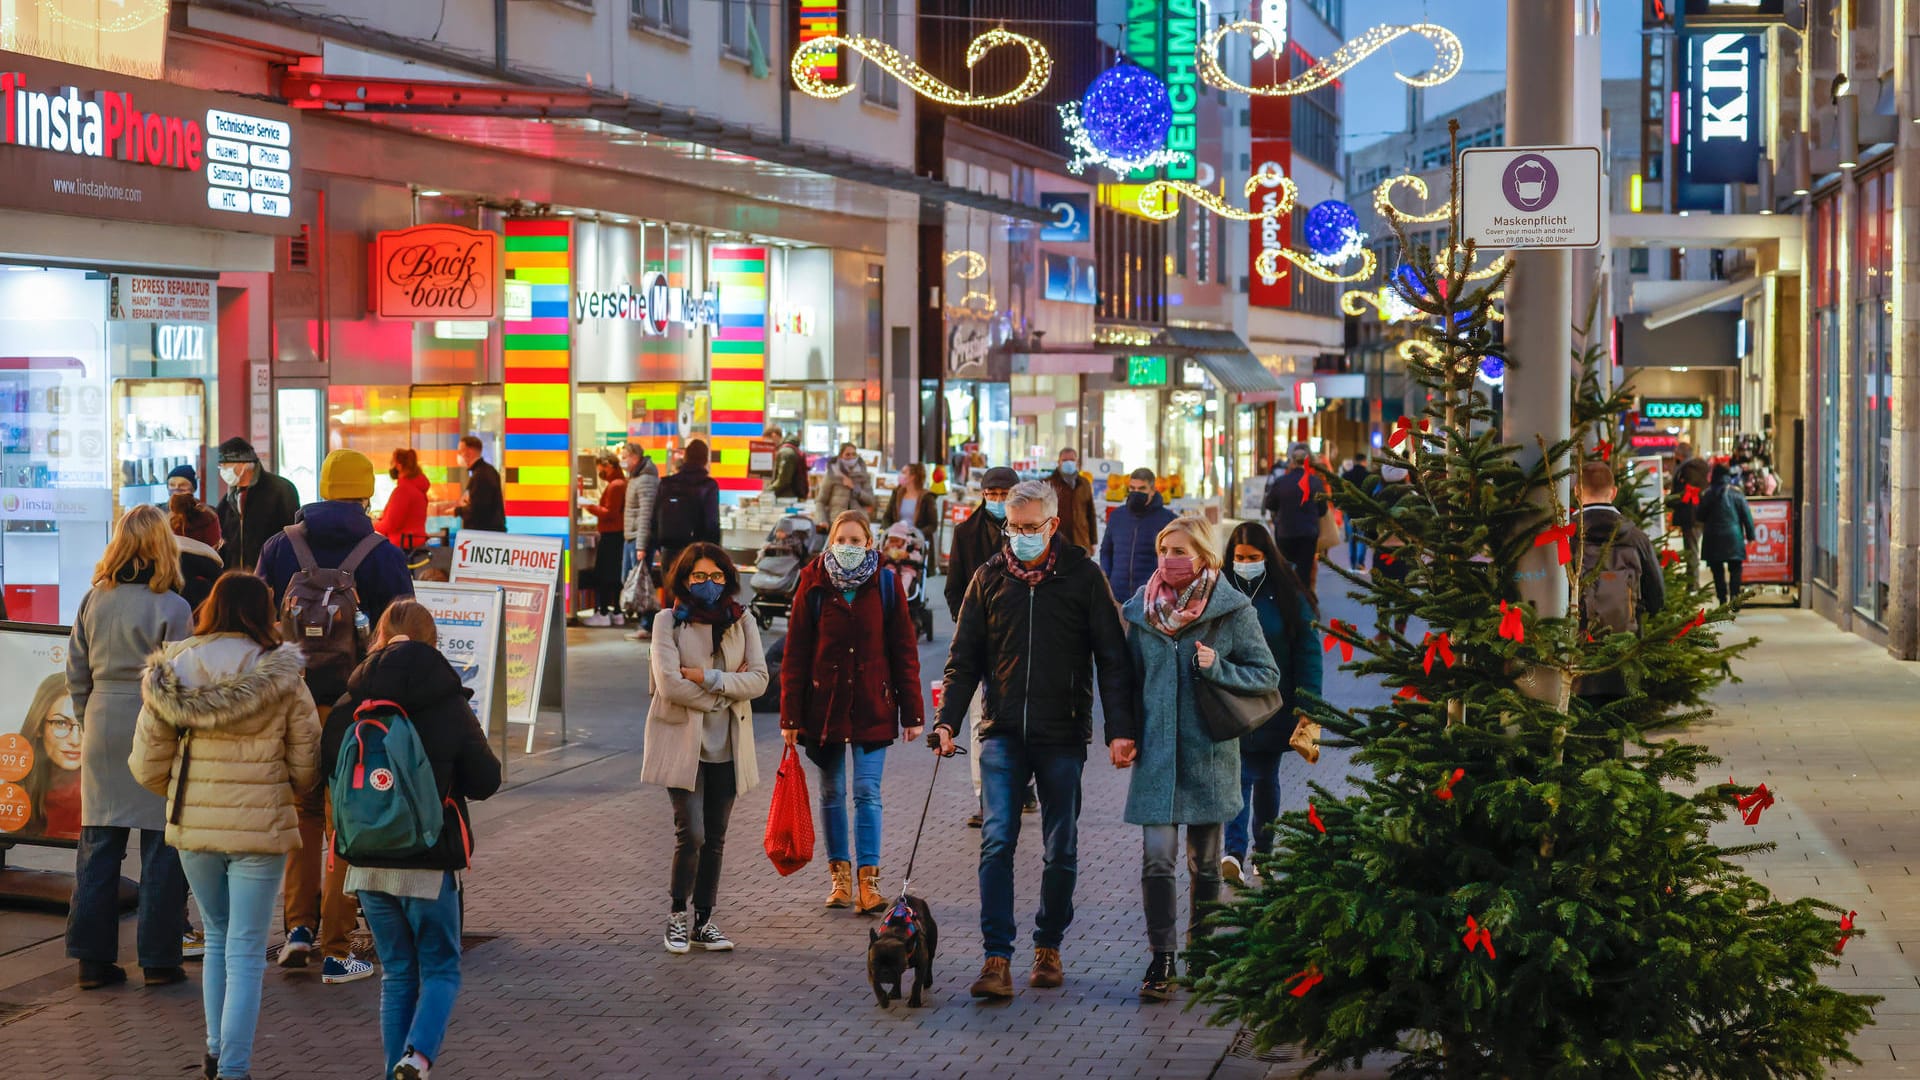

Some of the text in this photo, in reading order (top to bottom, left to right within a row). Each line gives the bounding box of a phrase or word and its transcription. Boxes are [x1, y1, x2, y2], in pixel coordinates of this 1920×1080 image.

[0, 72, 202, 172] 1instaPhone
[216, 115, 280, 140] Technischer Service
[215, 143, 239, 160] Huawei
[258, 147, 279, 164] iPhone
[213, 165, 243, 185] Samsung
[254, 173, 284, 190] LG Mobile
[53, 178, 142, 202] www.1instaphone.com
[222, 192, 237, 208] HTC
[262, 196, 278, 213] Sony
[1494, 215, 1567, 227] Maskenpflicht
[1521, 227, 1543, 235] mouth
[1544, 226, 1556, 234] and
[1557, 226, 1576, 234] nose!
[387, 241, 482, 287] Back
[132, 278, 210, 296] EXPRESS REPARATUR
[132, 309, 163, 319] REPARATUR
[448, 638, 475, 650] 50€
[10, 736, 17, 749] 3
[7, 786, 14, 798] 3
